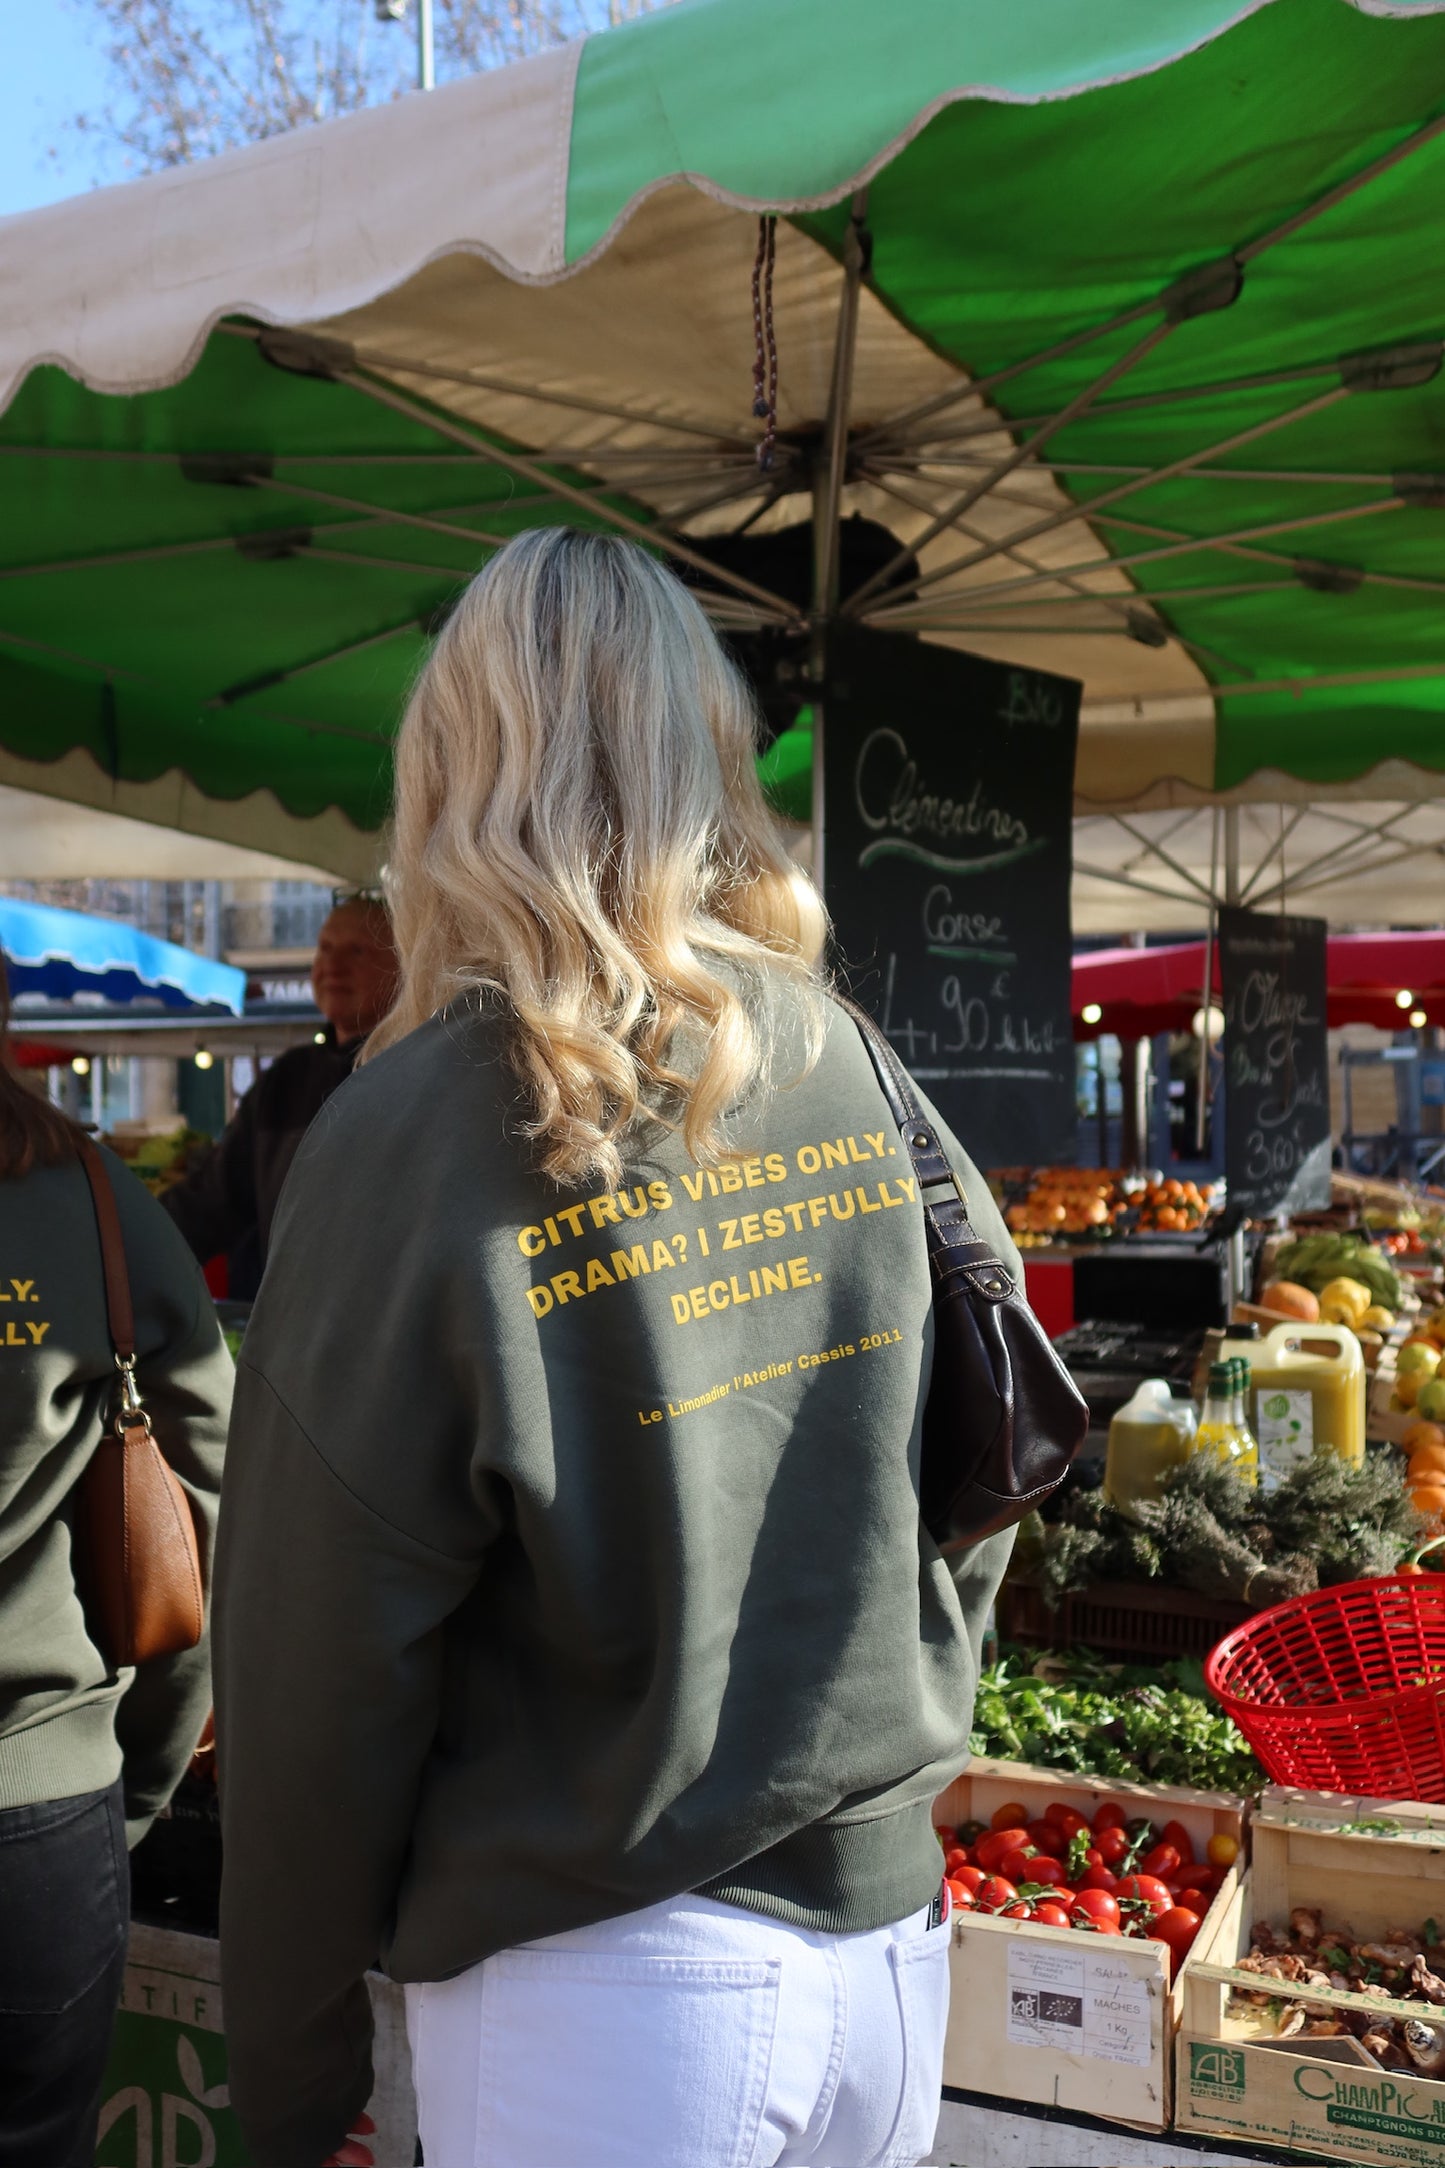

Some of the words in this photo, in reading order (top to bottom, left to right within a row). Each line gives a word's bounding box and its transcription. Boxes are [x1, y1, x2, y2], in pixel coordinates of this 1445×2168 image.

[855, 727, 1028, 847] Clémentines
[262, 980, 314, 1002] TABA
[517, 1181, 674, 1259] CITRUS
[680, 1152, 788, 1201] VIBES
[797, 1131, 896, 1175] ONLY.
[525, 1234, 689, 1320] DRAMA?
[698, 1228, 710, 1257] I
[718, 1177, 917, 1250] ZESTFULLY
[670, 1256, 823, 1326] DECLINE.
[0, 1322, 50, 1345] LY
[638, 1406, 664, 1426] Le
[668, 1382, 731, 1418] Limonadier
[734, 1360, 793, 1391] l'Atelier
[797, 1344, 856, 1371] Cassis
[859, 1328, 904, 1353] 2011
[1093, 1998, 1141, 2015] MACHES
[1107, 2022, 1112, 2031] 1
[1115, 2023, 1128, 2036] Kg
[1194, 2052, 1239, 2085] AB
[1332, 2110, 1425, 2136] CHAMPIGNONS
